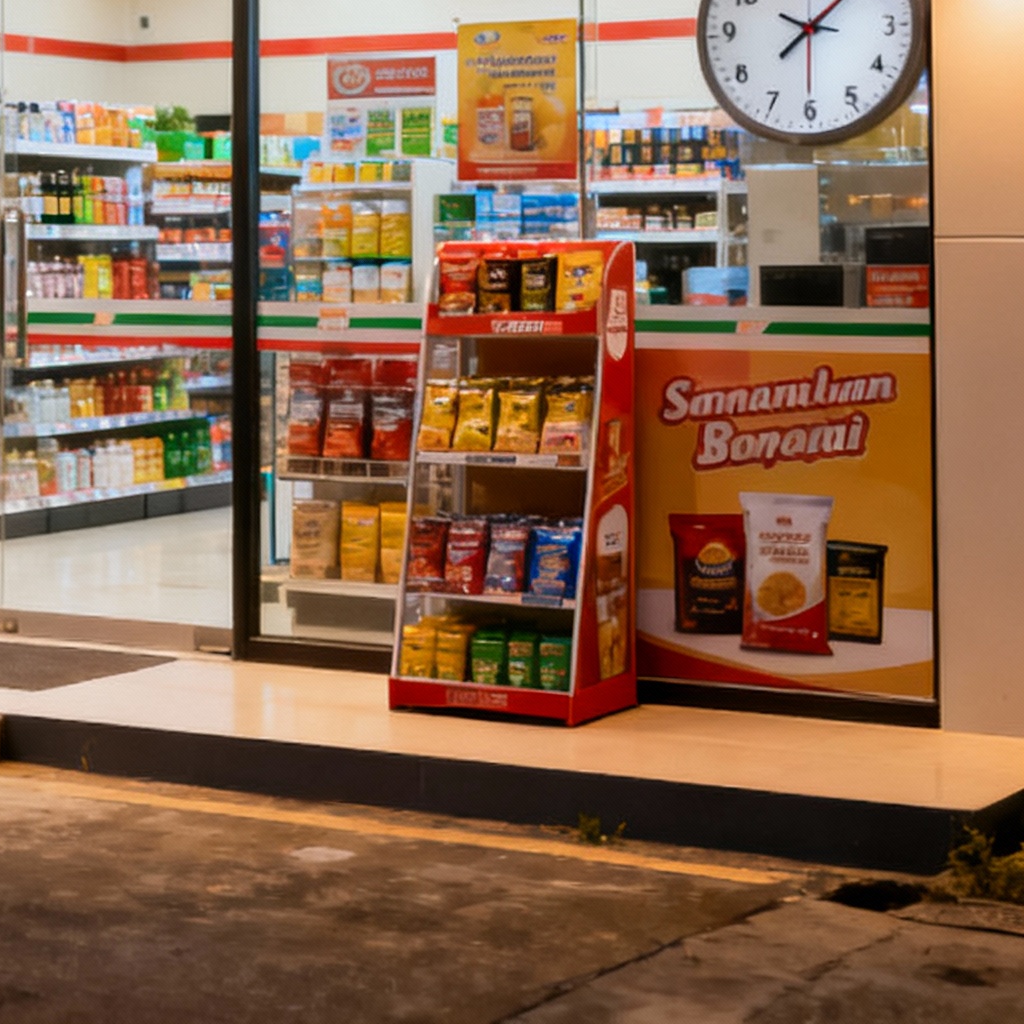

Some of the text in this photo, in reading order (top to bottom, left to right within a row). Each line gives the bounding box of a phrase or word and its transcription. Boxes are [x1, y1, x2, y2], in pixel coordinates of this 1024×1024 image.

[722, 21, 736, 42] 9
[882, 15, 895, 36] 3
[870, 54, 884, 73] 4
[767, 90, 779, 114] 7
[845, 85, 859, 111] 5
[804, 99, 816, 121] 6
